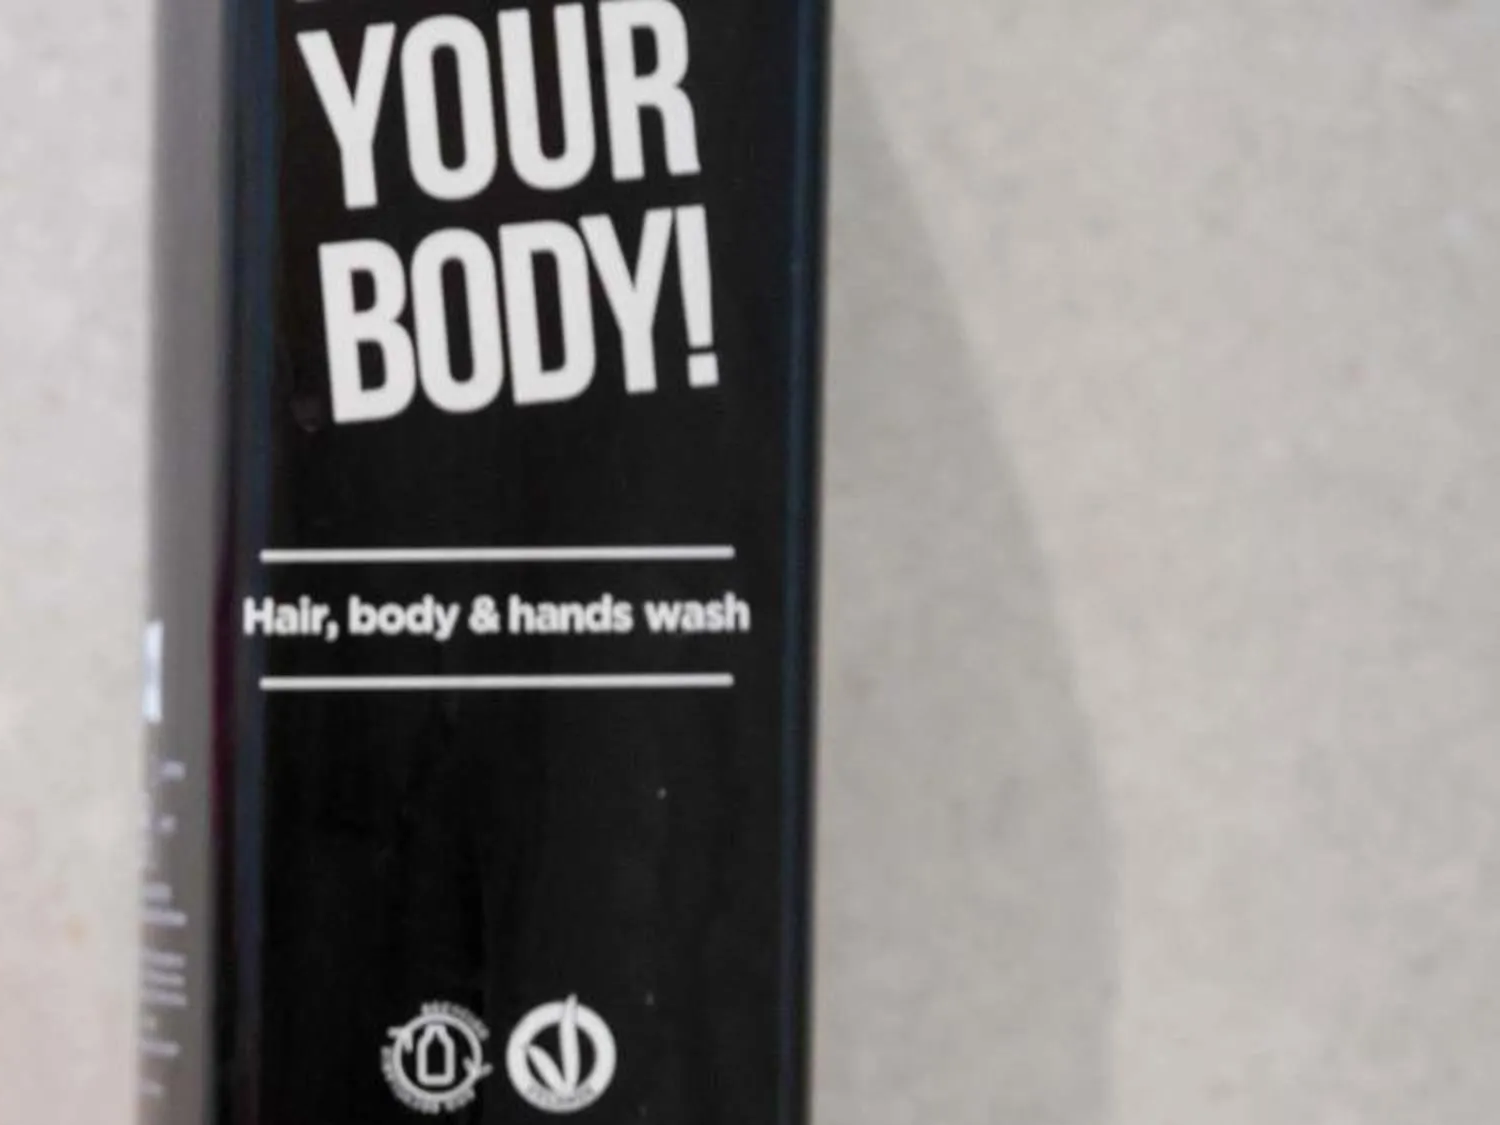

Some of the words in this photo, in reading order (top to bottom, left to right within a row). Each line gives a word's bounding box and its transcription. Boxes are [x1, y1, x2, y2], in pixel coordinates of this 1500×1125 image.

[296, 0, 701, 209] YOUR
[318, 204, 719, 423] BODY!
[242, 595, 339, 641] Hair,
[348, 594, 460, 641] body
[468, 595, 500, 634] &
[508, 592, 634, 634] hands
[643, 591, 751, 633] wash
